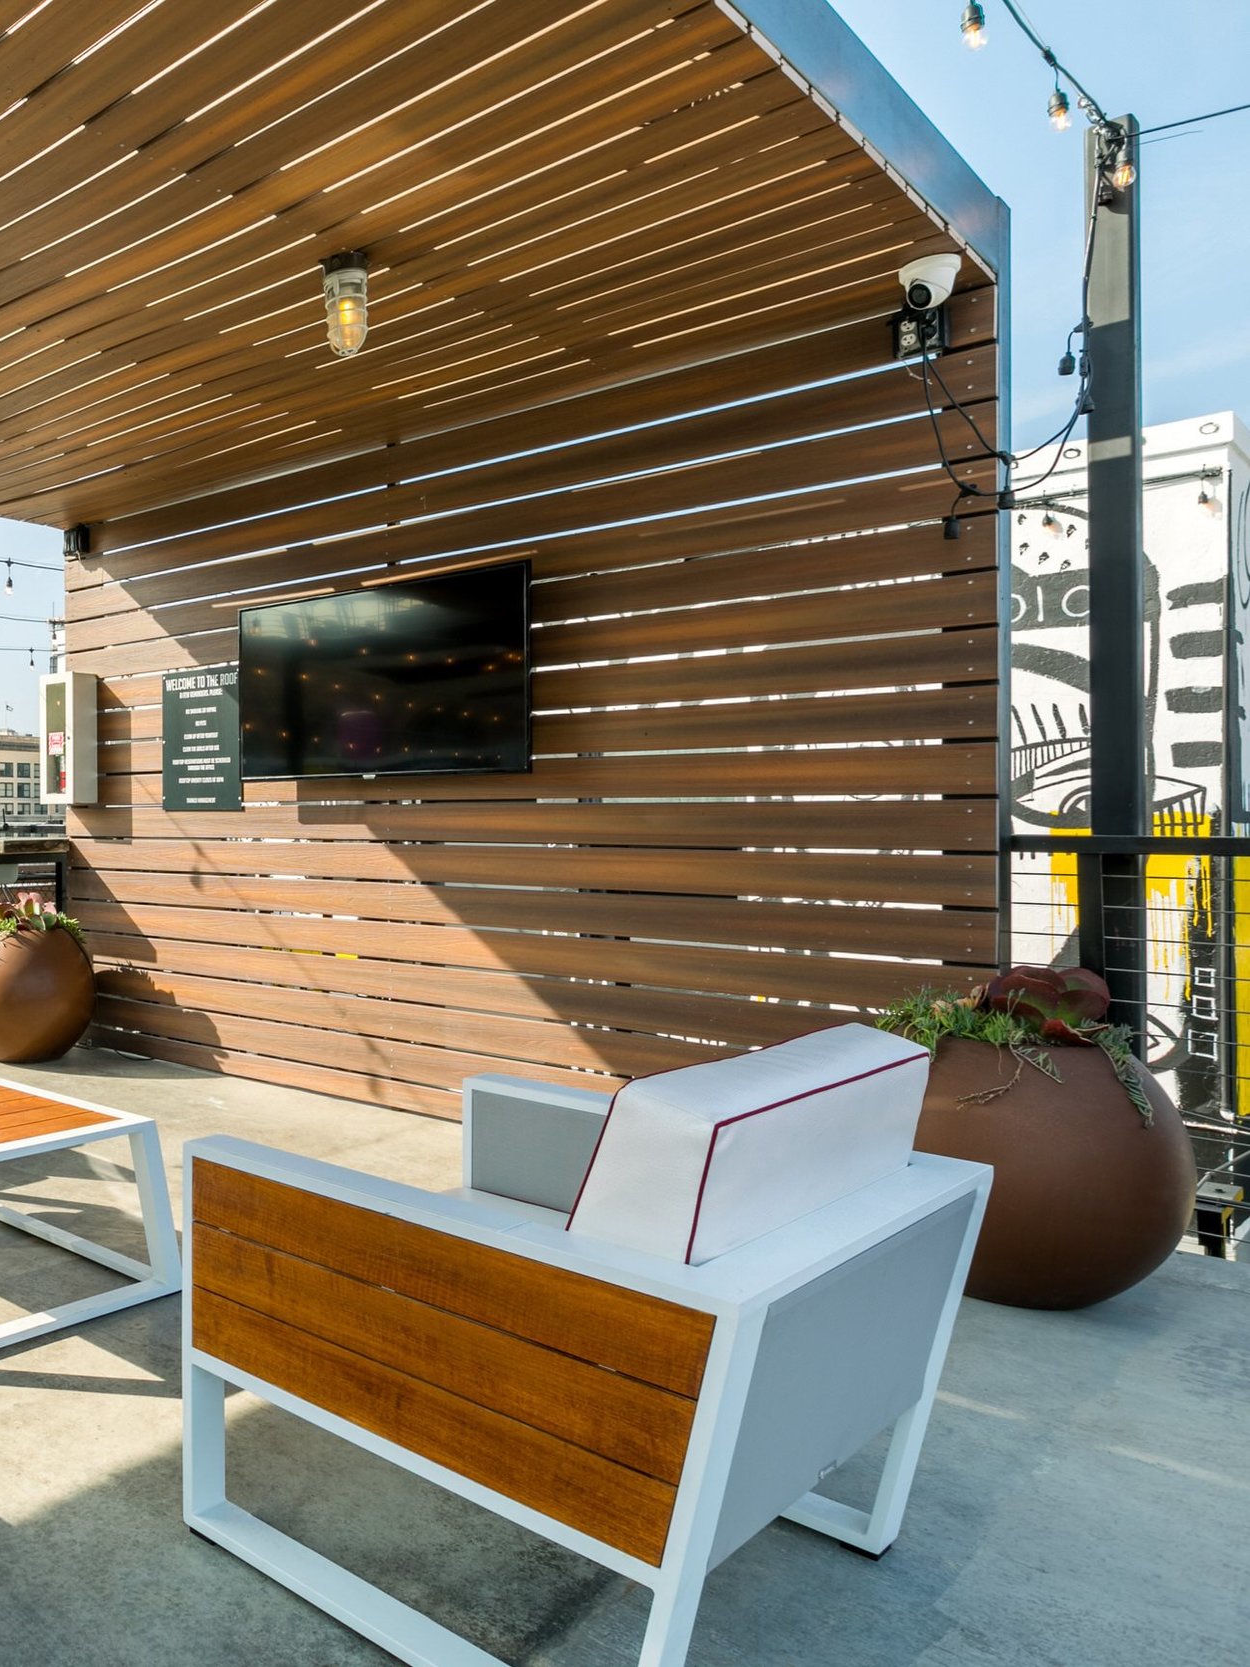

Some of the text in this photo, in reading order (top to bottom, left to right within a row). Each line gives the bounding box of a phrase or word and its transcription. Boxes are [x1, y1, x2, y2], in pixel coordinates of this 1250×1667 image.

[166, 672, 238, 691] WELCOME TO THE ROOF
